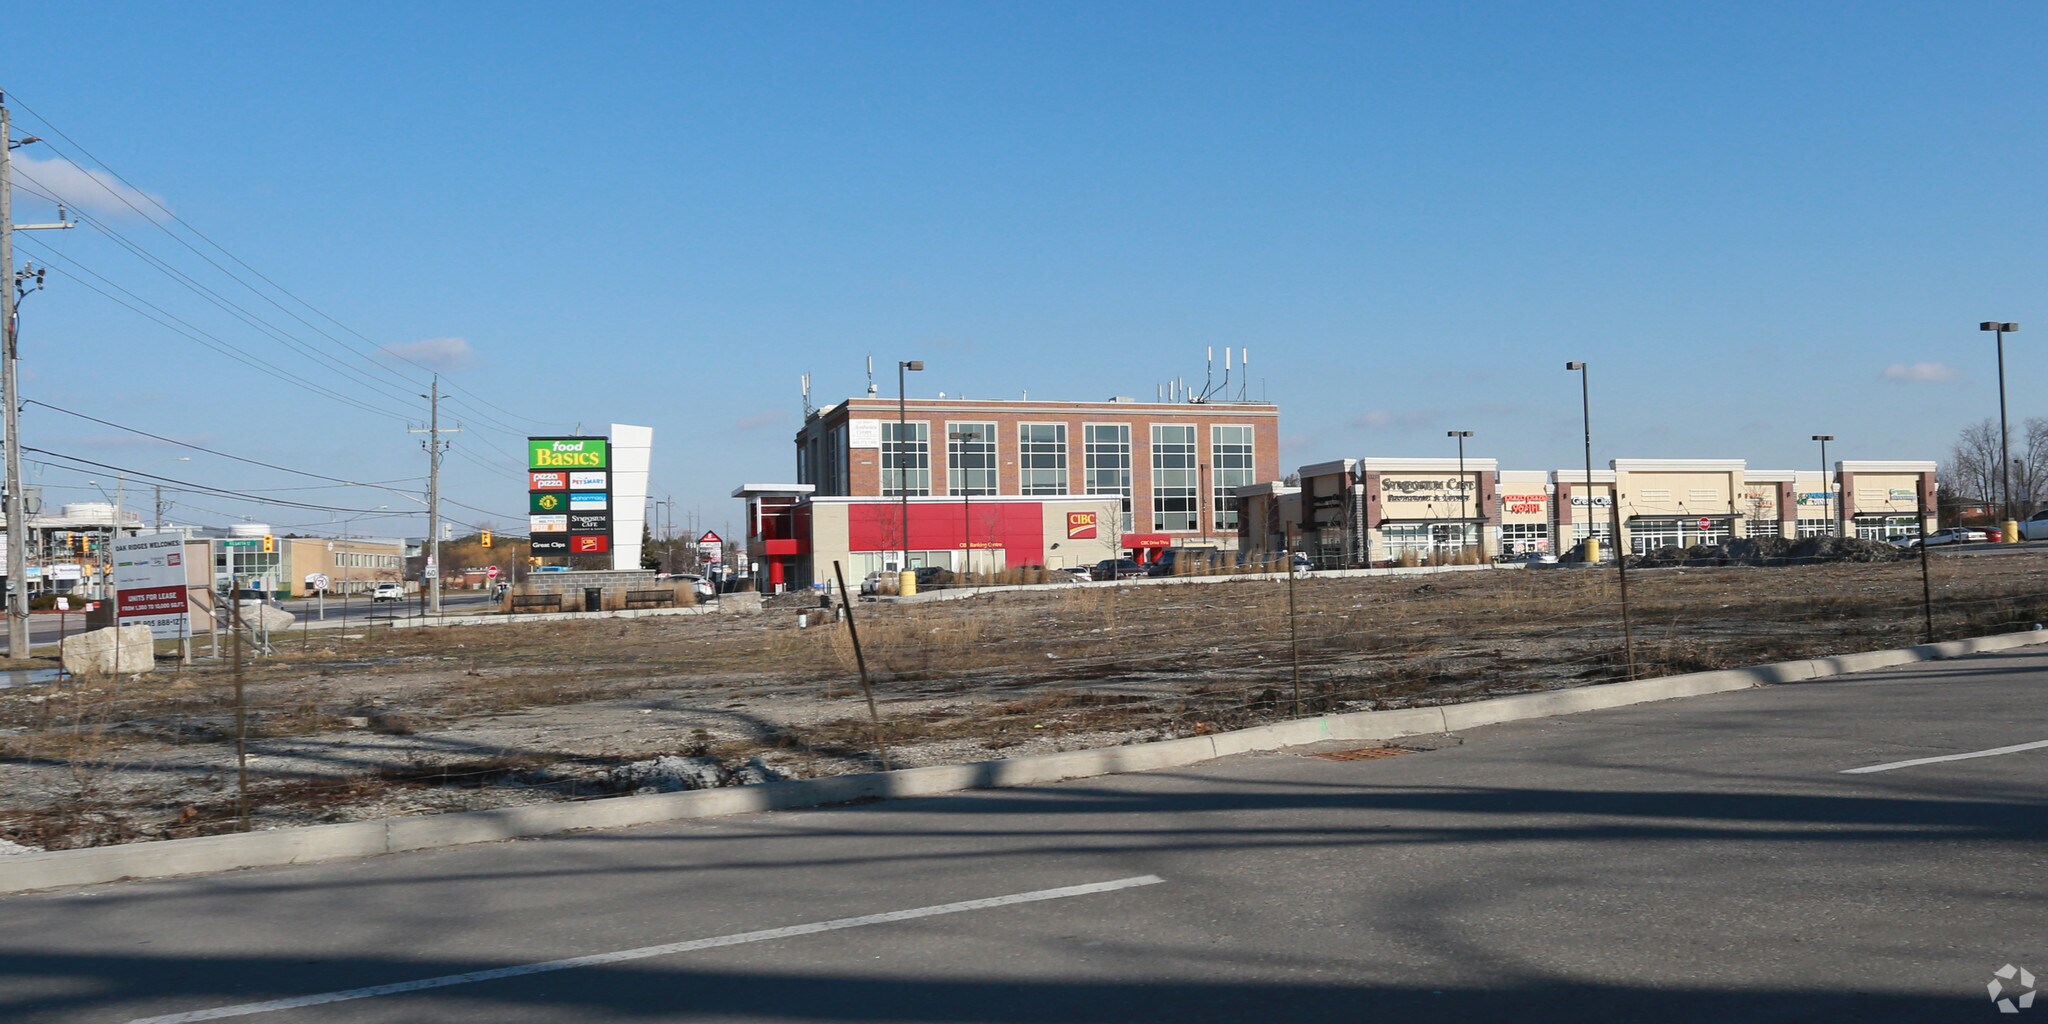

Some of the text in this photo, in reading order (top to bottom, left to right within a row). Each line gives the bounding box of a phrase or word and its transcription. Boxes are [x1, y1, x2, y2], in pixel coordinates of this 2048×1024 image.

[553, 441, 584, 451] food
[1070, 514, 1095, 524] CIBC
[426, 569, 436, 577] 60
[146, 593, 157, 601] FOR
[158, 592, 177, 600] LEASE
